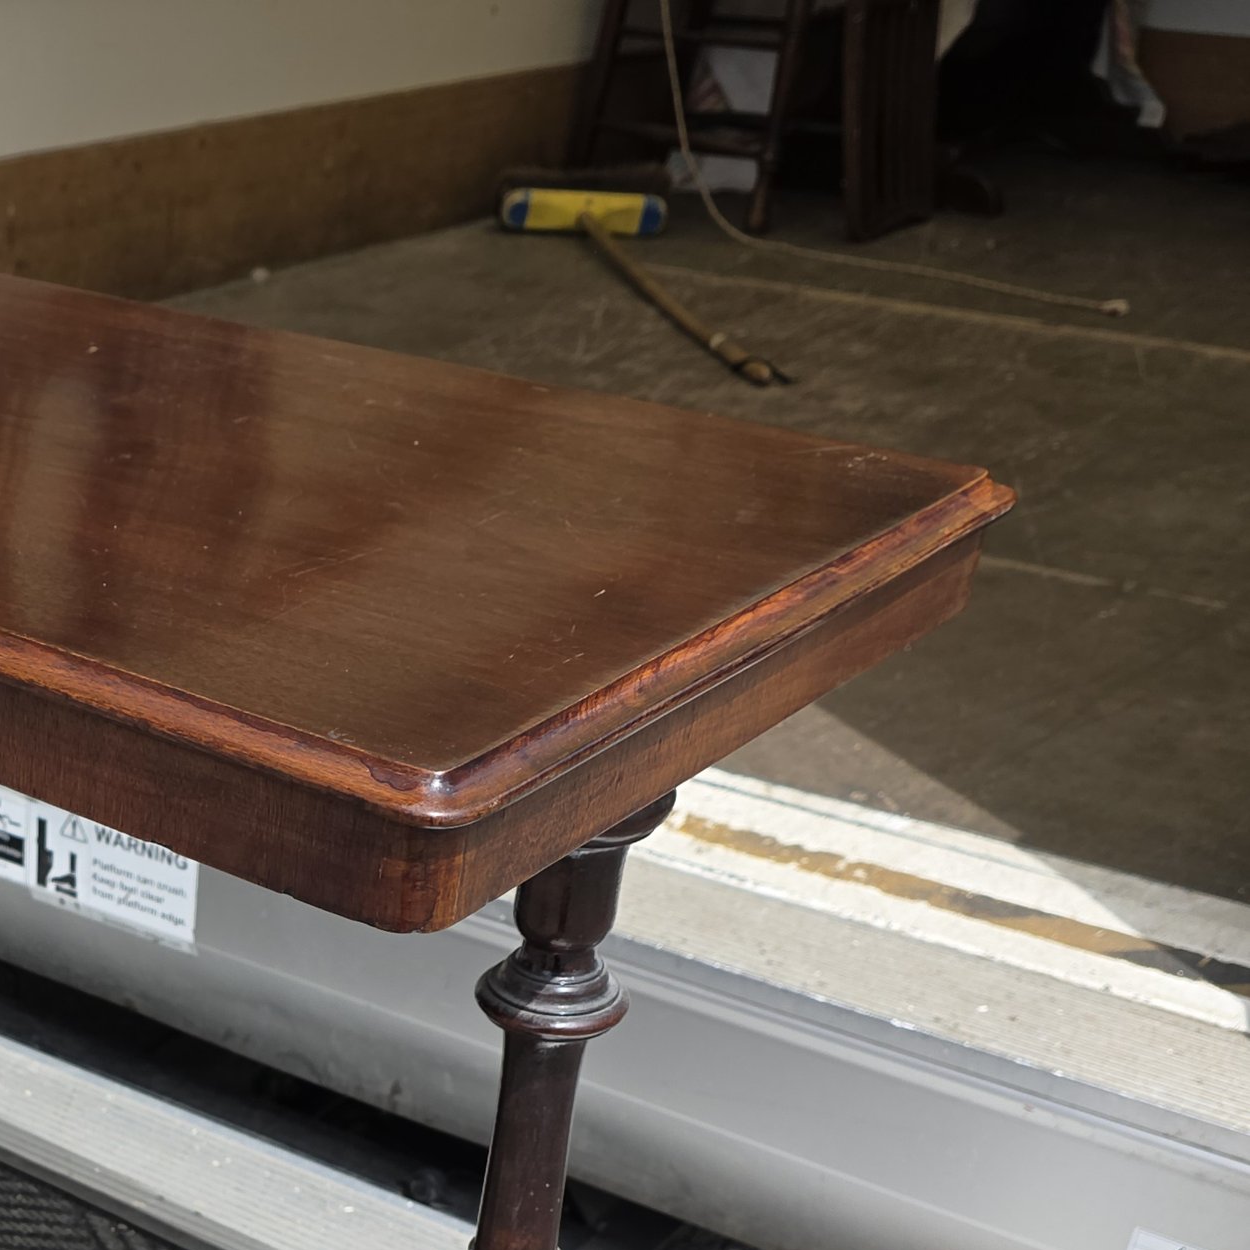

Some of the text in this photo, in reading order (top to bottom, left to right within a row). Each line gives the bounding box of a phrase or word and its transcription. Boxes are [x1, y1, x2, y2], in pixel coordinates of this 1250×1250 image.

[94, 824, 188, 870] WARNING
[92, 858, 133, 879] Platform
[136, 873, 155, 887] can
[92, 872, 116, 889] Keep
[140, 887, 165, 904] clear
[91, 886, 114, 900] from
[116, 897, 157, 916] platform
